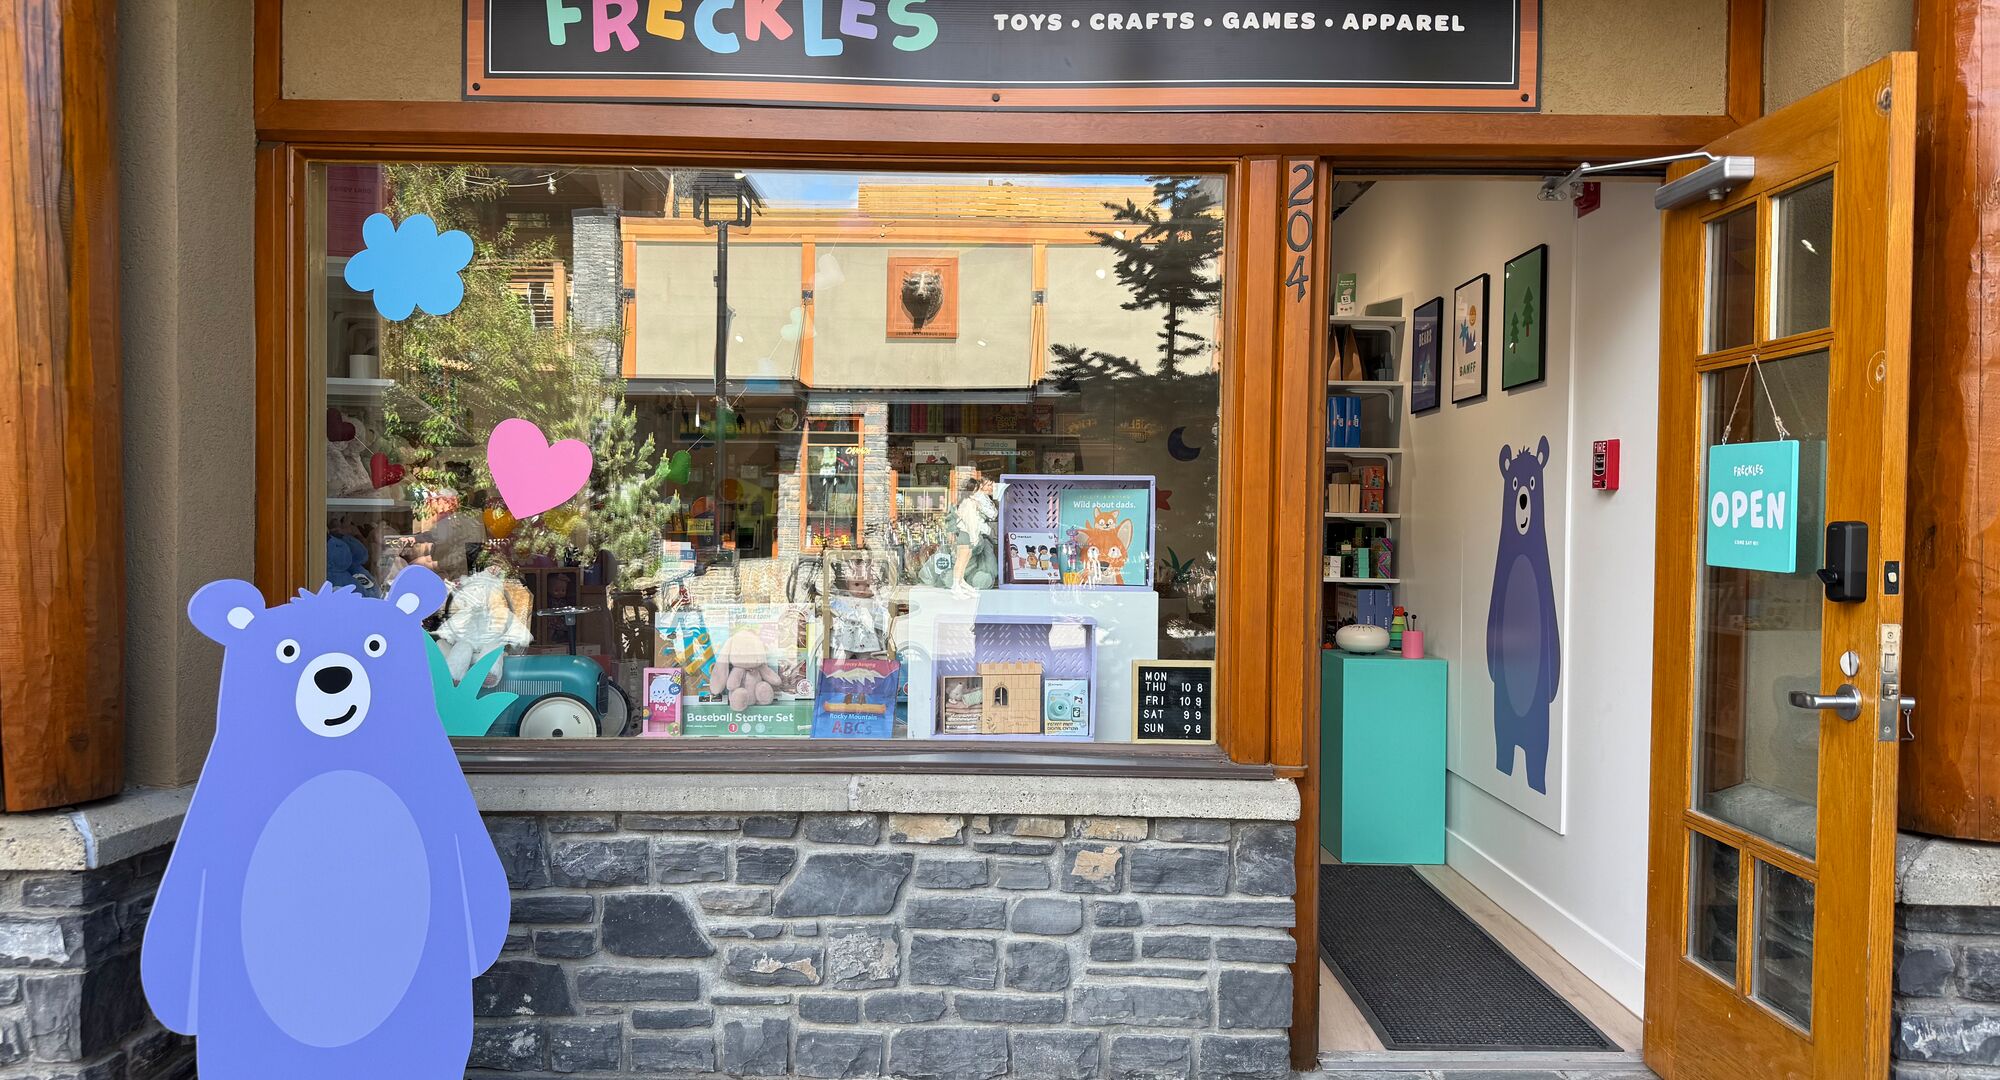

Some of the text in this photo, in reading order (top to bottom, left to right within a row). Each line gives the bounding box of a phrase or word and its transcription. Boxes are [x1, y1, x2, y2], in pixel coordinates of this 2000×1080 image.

[993, 12, 1466, 33] TOYS CRAFTS GAMES APPAREL
[545, 0, 939, 57] FRECKLES
[1285, 163, 1315, 303] 204
[1459, 361, 1477, 377] BANFF
[1594, 442, 1606, 453] FIRE
[1734, 464, 1764, 477] FRECKLES
[1073, 500, 1136, 509] Wild about dads.
[1711, 489, 1786, 530] OPEN
[1145, 672, 1167, 681] MON
[1145, 682, 1203, 692] THU 10 8
[1145, 695, 1202, 706] FRI 10 9
[655, 704, 668, 712] Pop
[686, 713, 794, 723] Baseball Starter Set
[829, 713, 848, 721] Rocky
[1143, 709, 1201, 720] SAT 9 9
[831, 720, 872, 735] ABCs
[1143, 723, 1201, 734] SUN 9 8
